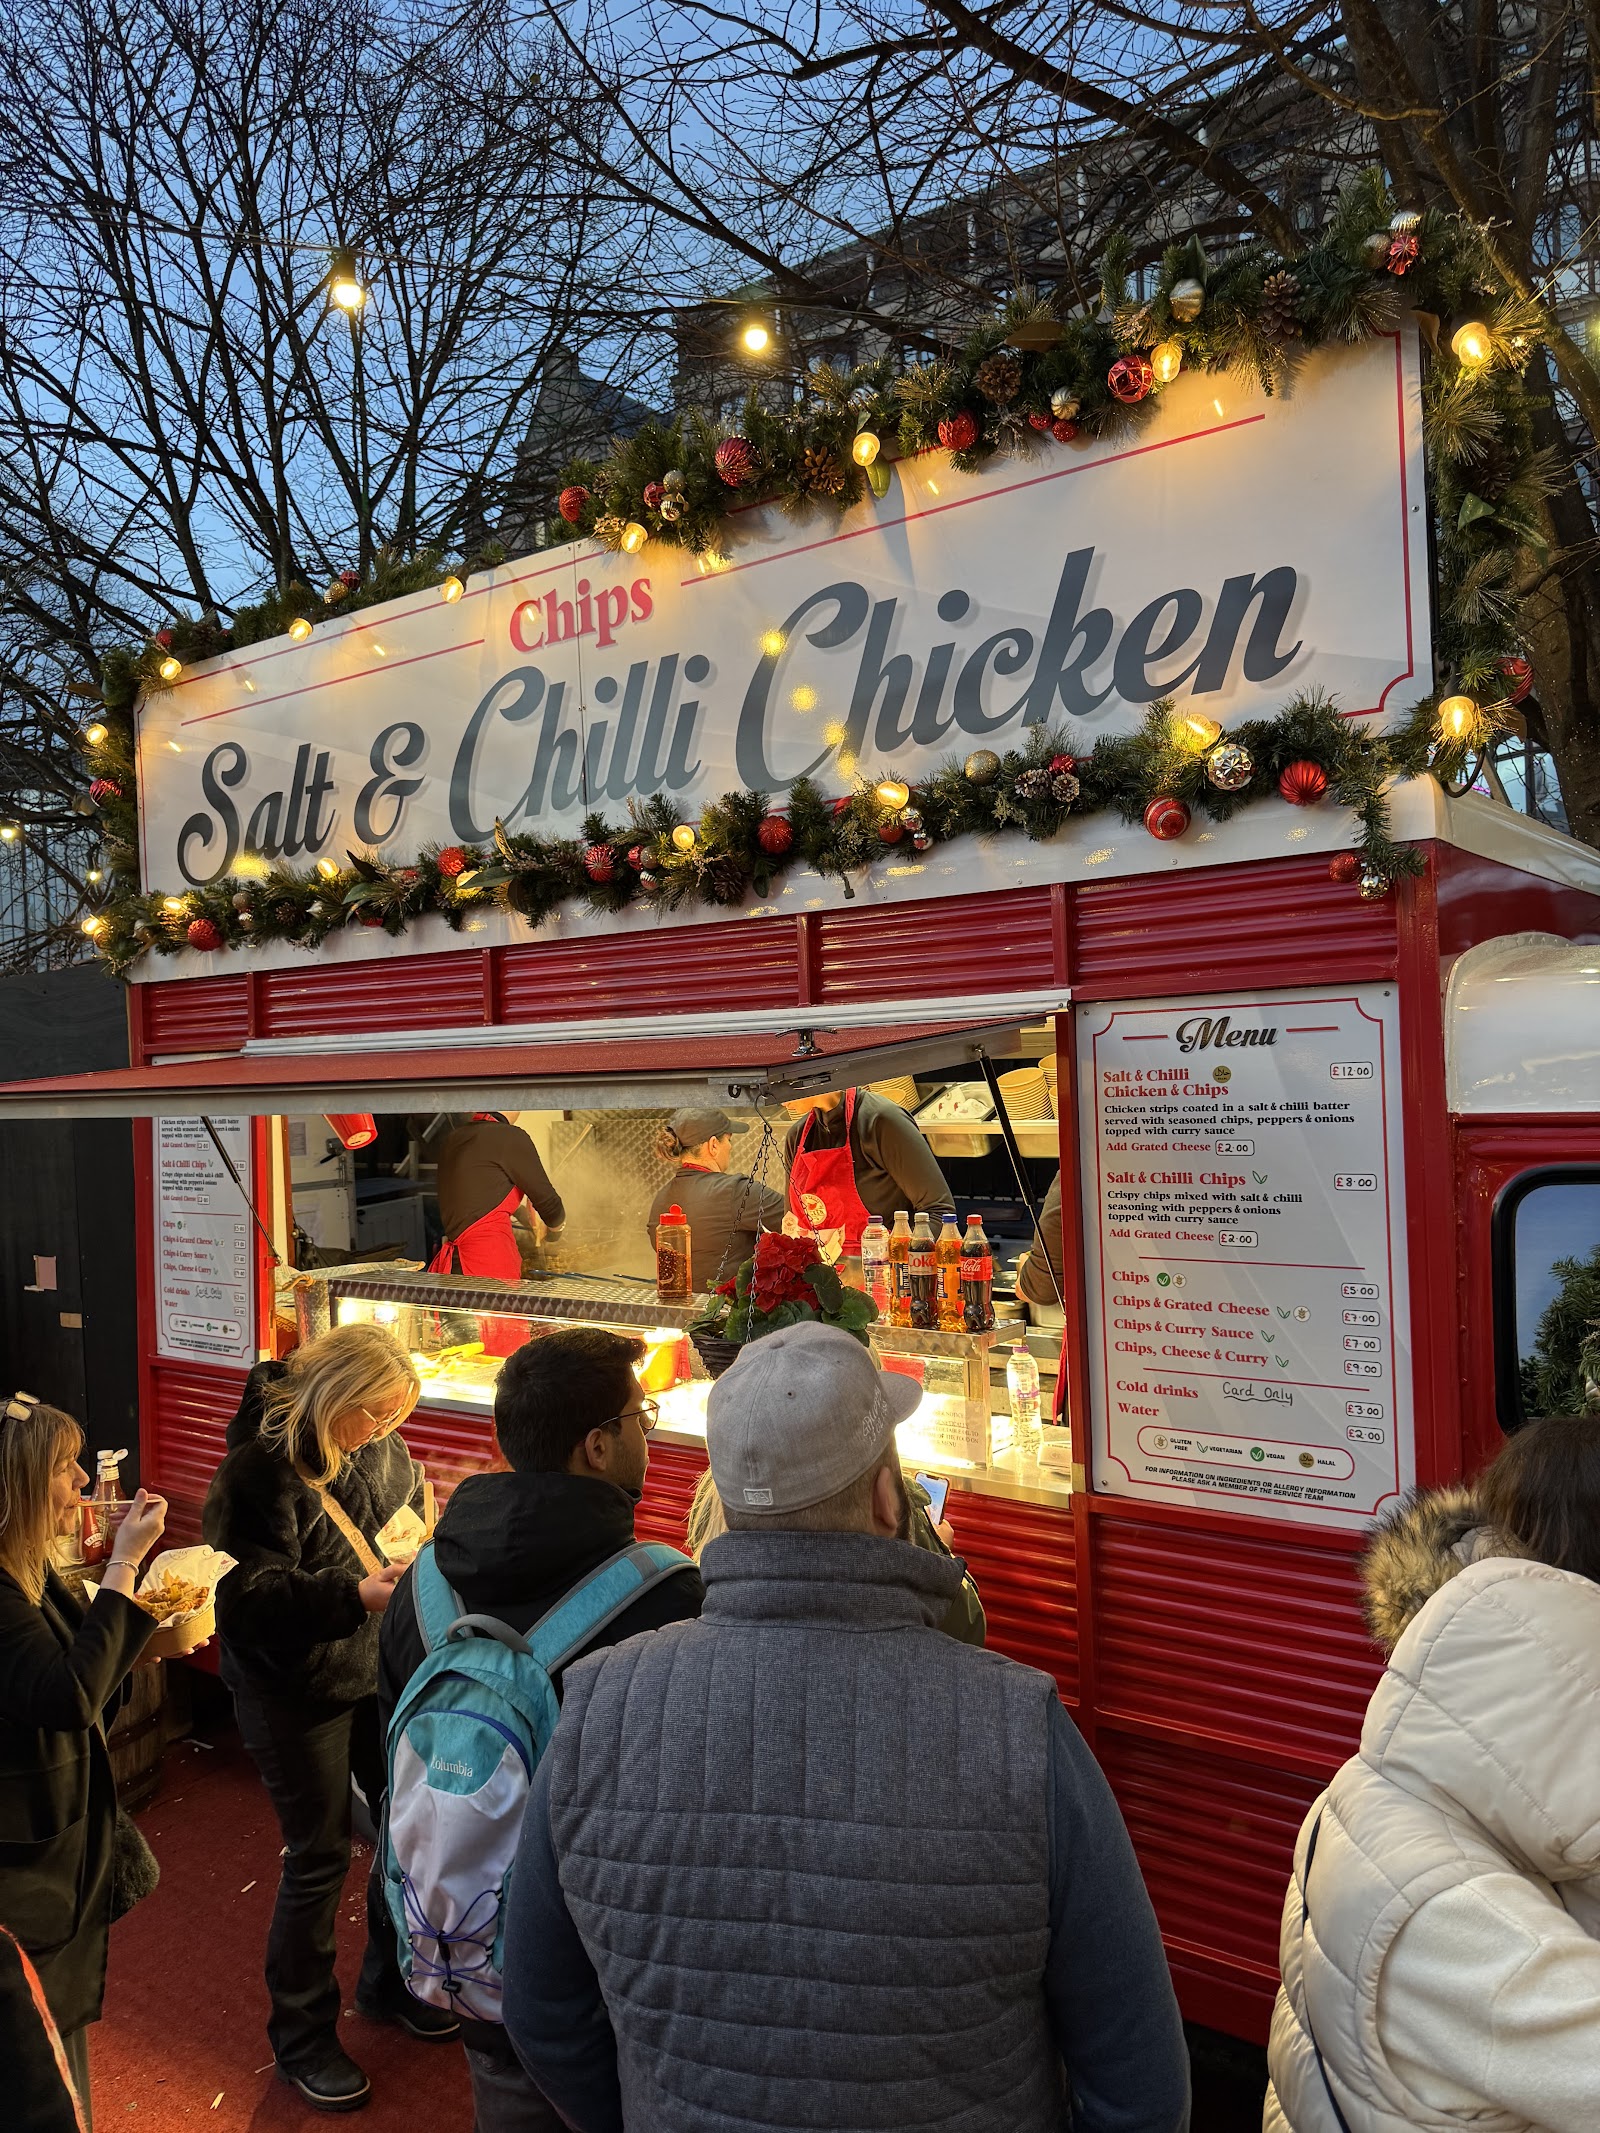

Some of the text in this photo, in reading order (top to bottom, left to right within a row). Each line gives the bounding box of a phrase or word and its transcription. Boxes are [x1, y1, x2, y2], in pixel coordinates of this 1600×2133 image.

[509, 577, 655, 652] Chips
[177, 546, 1303, 887] Salt & Chilli Chicken
[1176, 1016, 1277, 1053] Menu
[1104, 1068, 1189, 1082] Salt & Chilli
[1104, 1083, 1228, 1098] Chicken & Chips
[1105, 1105, 1146, 1113] Chicken
[1150, 1105, 1178, 1114] strips
[1182, 1104, 1218, 1112] coated
[1223, 1103, 1234, 1111] in
[1249, 1103, 1269, 1111] salt
[1271, 1102, 1277, 1110] &
[1279, 1102, 1309, 1110] chilli
[1314, 1102, 1350, 1110] batter
[1105, 1117, 1138, 1125] served
[1169, 1116, 1216, 1124] seasoned
[1221, 1115, 1253, 1125] chips,
[1257, 1117, 1303, 1125] peppers
[1306, 1114, 1312, 1122] &
[1314, 1114, 1354, 1123] onions
[1106, 1127, 1141, 1137] topped
[1131, 1142, 1168, 1151] Grated
[1172, 1142, 1211, 1151] Cheese
[1107, 1171, 1246, 1188] Salt & Chilli Chips
[1108, 1191, 1140, 1201] Crispy
[1144, 1191, 1170, 1201] chips
[1175, 1192, 1208, 1200] mixed
[1212, 1193, 1236, 1201] with
[1263, 1193, 1269, 1201] &
[1273, 1194, 1302, 1202] chilli
[1108, 1203, 1281, 1215] seasoning with peppers & onions
[1109, 1213, 1144, 1222] topped
[1175, 1216, 1204, 1225] curry
[1110, 1229, 1214, 1241] Add Grated Cheese
[1112, 1271, 1149, 1285] Chips
[1113, 1296, 1269, 1316] Chips & Grated Cheese
[1114, 1319, 1254, 1339] Chips & Curry Sauce
[1115, 1342, 1268, 1367] Chips, Cheese & Curry
[1117, 1381, 1198, 1398] Cold drinks
[1222, 1381, 1293, 1406] Card Only
[1118, 1403, 1159, 1416] Water
[1159, 1468, 1203, 1478] INFORMATION
[1217, 1476, 1260, 1487] INGREDIENTS
[1273, 1481, 1304, 1492] ALLERGY
[1306, 1485, 1355, 1499] INFORMATION
[1218, 1482, 1247, 1490] MEMBER
[1248, 1485, 1257, 1493] OF
[1274, 1490, 1302, 1498] SERVICE
[1304, 1493, 1323, 1501] TEAM
